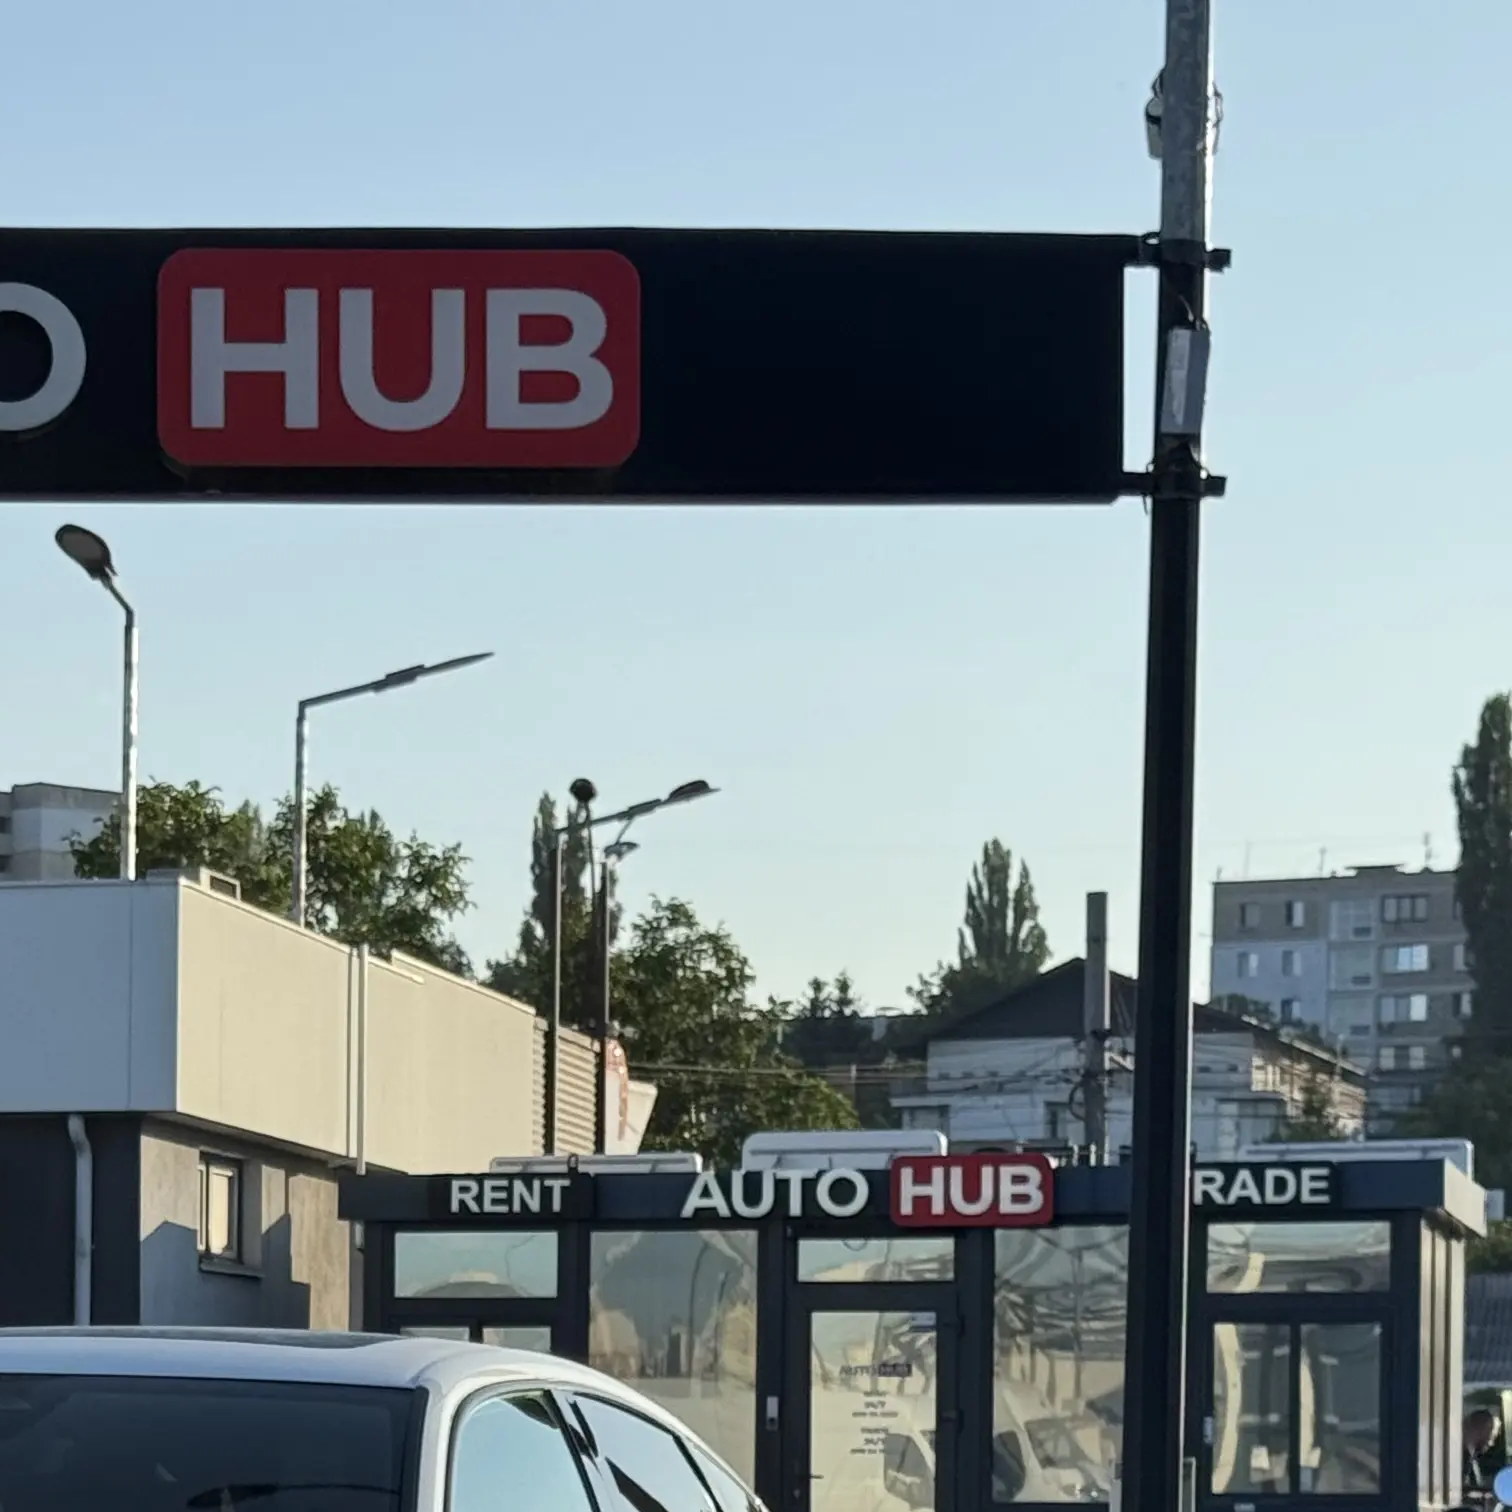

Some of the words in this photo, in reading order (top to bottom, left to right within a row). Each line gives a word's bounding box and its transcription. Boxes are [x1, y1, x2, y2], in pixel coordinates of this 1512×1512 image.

[189, 287, 614, 431] HUB
[449, 1178, 572, 1214] RENT
[680, 1168, 870, 1219] AUTO
[899, 1164, 1045, 1216] HUB
[1191, 1167, 1331, 1206] RADE
